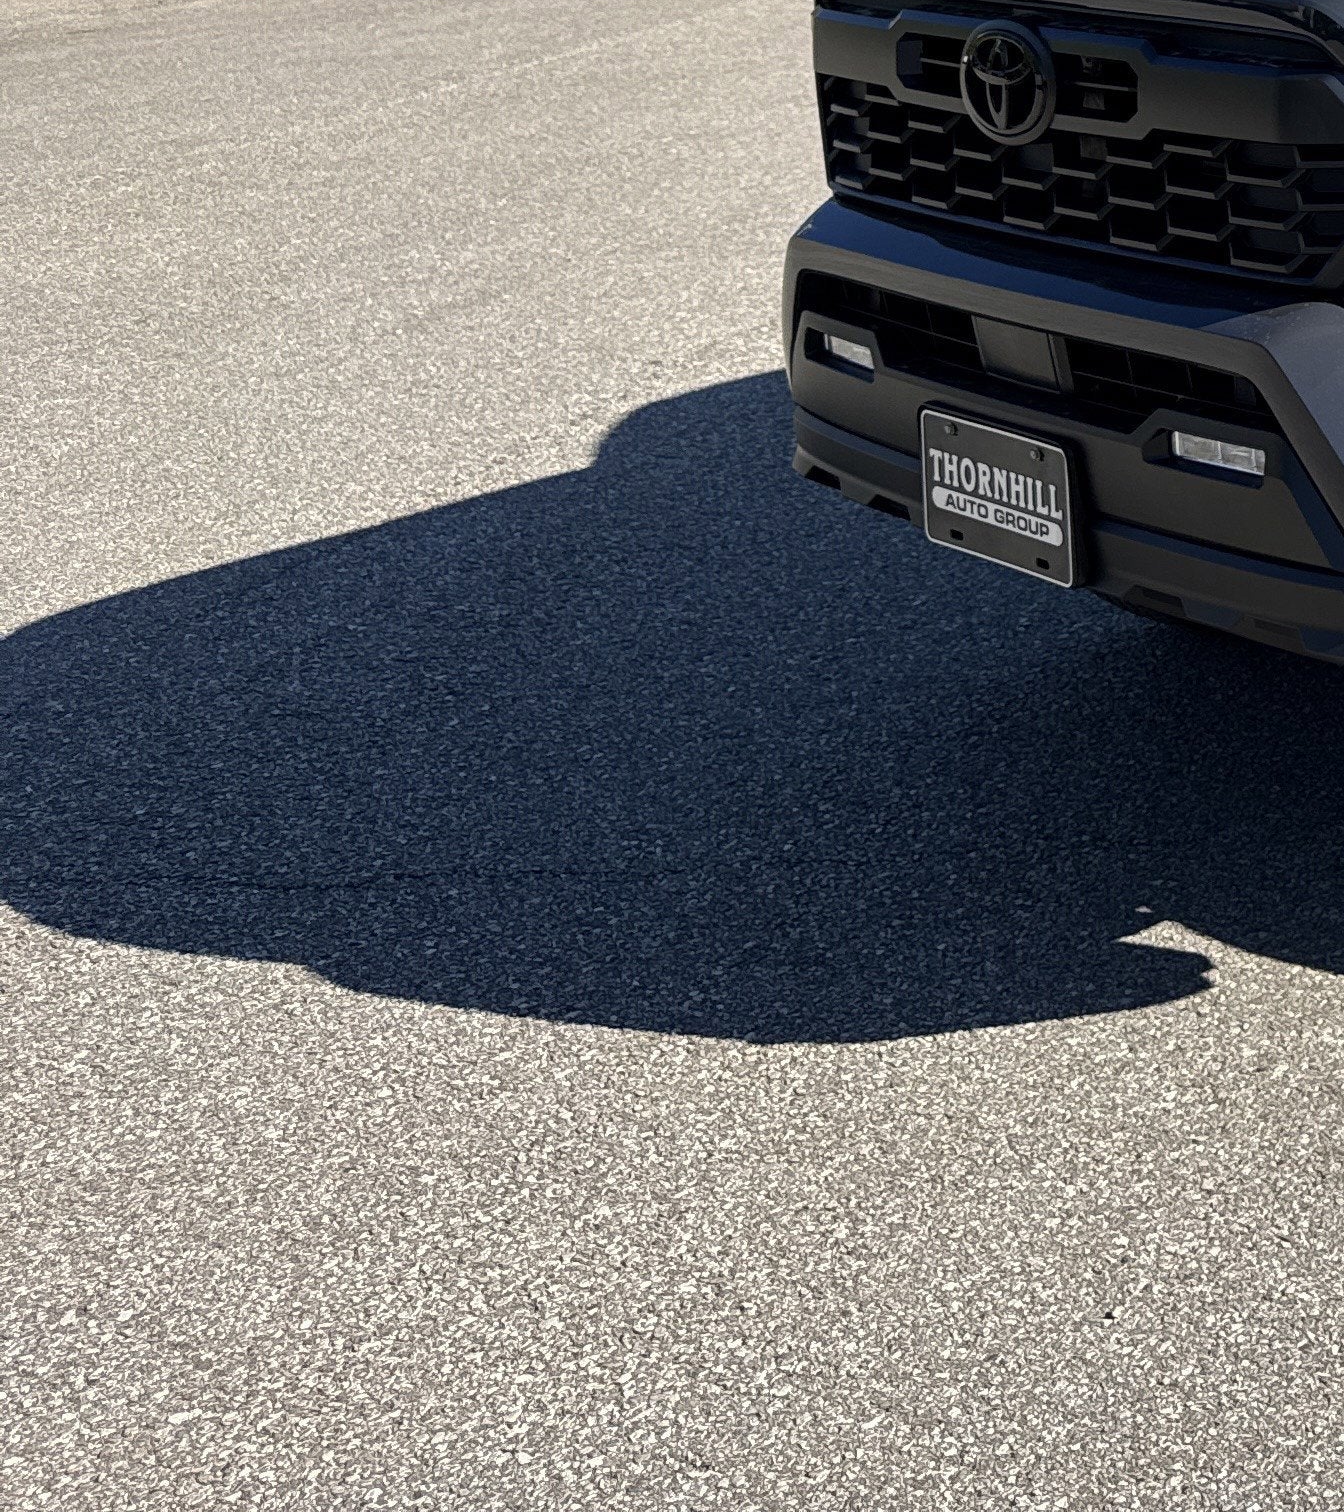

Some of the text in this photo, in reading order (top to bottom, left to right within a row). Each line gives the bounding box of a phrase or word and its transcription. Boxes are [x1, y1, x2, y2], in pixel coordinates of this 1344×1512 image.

[929, 447, 1063, 522] THORNHILL
[945, 493, 1050, 538] AUTO GROUP
